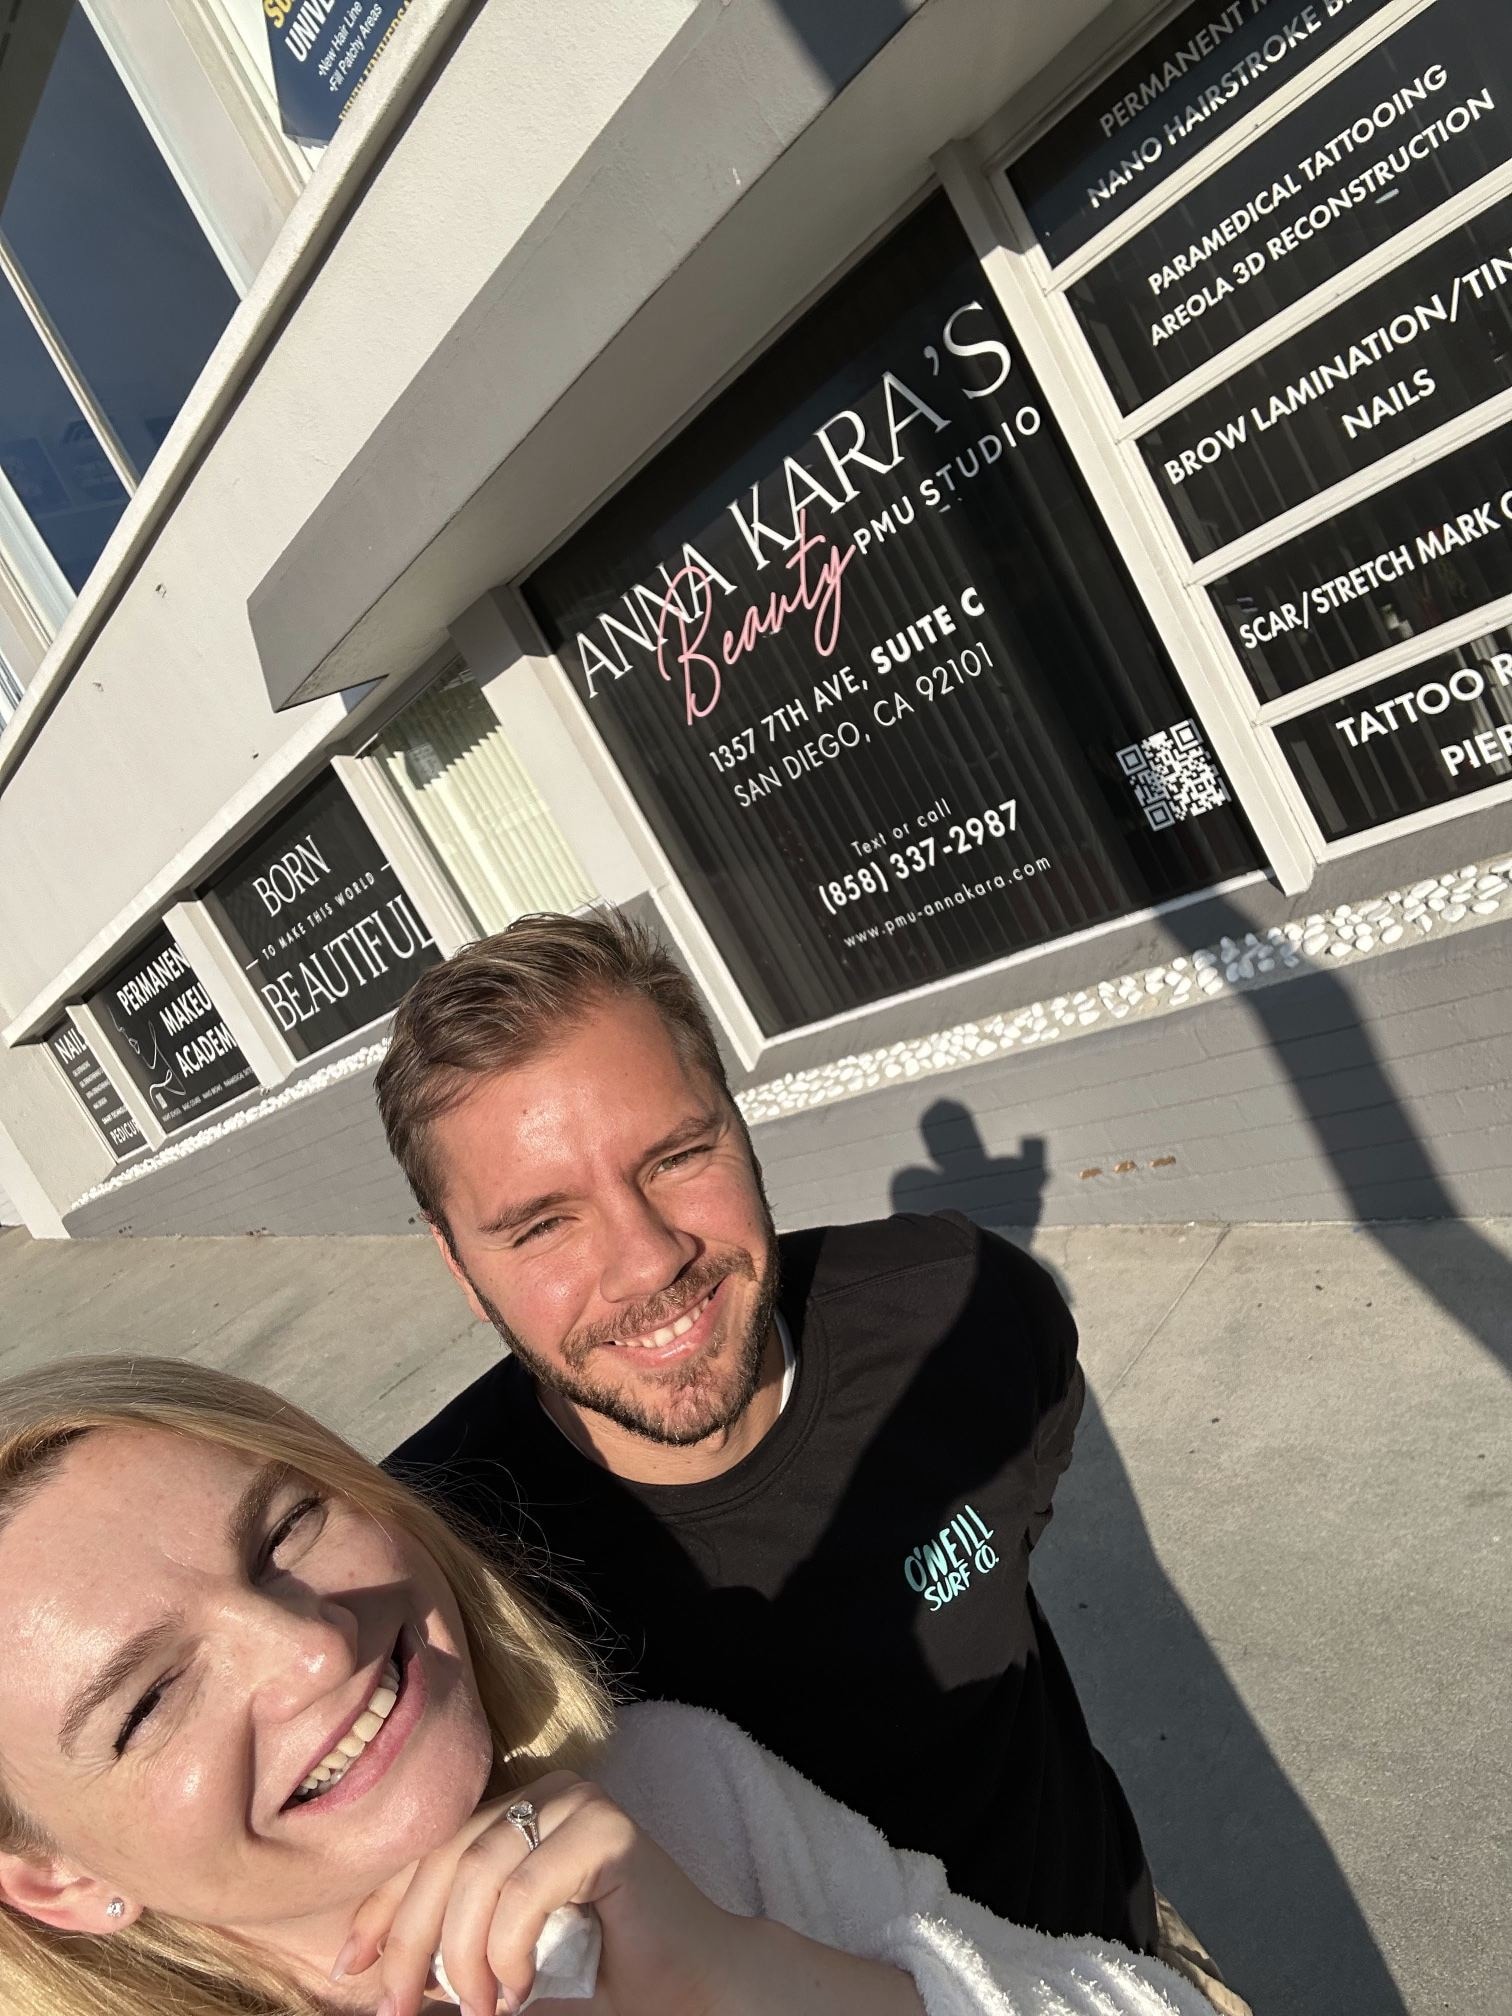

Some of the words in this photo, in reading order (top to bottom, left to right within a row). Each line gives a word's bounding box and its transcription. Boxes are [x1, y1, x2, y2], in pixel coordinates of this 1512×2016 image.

[318, 49, 337, 75] New
[331, 24, 350, 51] Hair
[344, 1, 363, 28] Line
[338, 36, 365, 75] Patchy
[359, 3, 382, 39] Areas
[1100, 1, 1244, 137] PERMANENT
[1087, 137, 1163, 208] NANO
[1163, 6, 1322, 145] HAIRSTROKE
[1148, 173, 1301, 295] PARAMEDICAL
[1298, 64, 1447, 181] TATTOOING
[1150, 277, 1235, 346] AREOLA
[1232, 251, 1266, 285] 3D
[1266, 88, 1495, 261] RECONSTRUCTION
[1164, 416, 1247, 485] BROW
[1342, 368, 1436, 439] NAILS
[853, 495, 916, 554] PMU
[920, 405, 1042, 506] STUDIO
[575, 541, 738, 699] ANNA
[657, 508, 857, 725] Beauty
[1239, 545, 1415, 649] SCAR/STRETCH
[1415, 502, 1501, 566] MARK
[709, 728, 756, 772] 1357
[760, 698, 809, 742] 7TH
[813, 665, 869, 713] AVE,
[870, 604, 957, 674] SUITE
[960, 586, 985, 617] C
[733, 766, 783, 808] SAN
[782, 721, 871, 780] DIEGO,
[873, 692, 914, 727] CA
[915, 641, 994, 702] 92101
[1335, 668, 1485, 747] TATTOO
[252, 835, 331, 917] BORN
[818, 861, 889, 915] (858)
[889, 798, 1017, 880] 337-2987
[851, 832, 887, 858] Text
[893, 821, 910, 839] or
[916, 797, 952, 828] call
[262, 944, 276, 960] TO
[278, 922, 307, 950] MAKE
[306, 902, 333, 928] THIS
[335, 871, 375, 907] WORLD
[843, 855, 1052, 948] www.pmu-annakara.com
[261, 894, 436, 1031] BEAUTIFUL
[54, 1026, 88, 1064] NAIL
[924, 1562, 971, 1612] SURF
[974, 1544, 999, 1574] CO.
